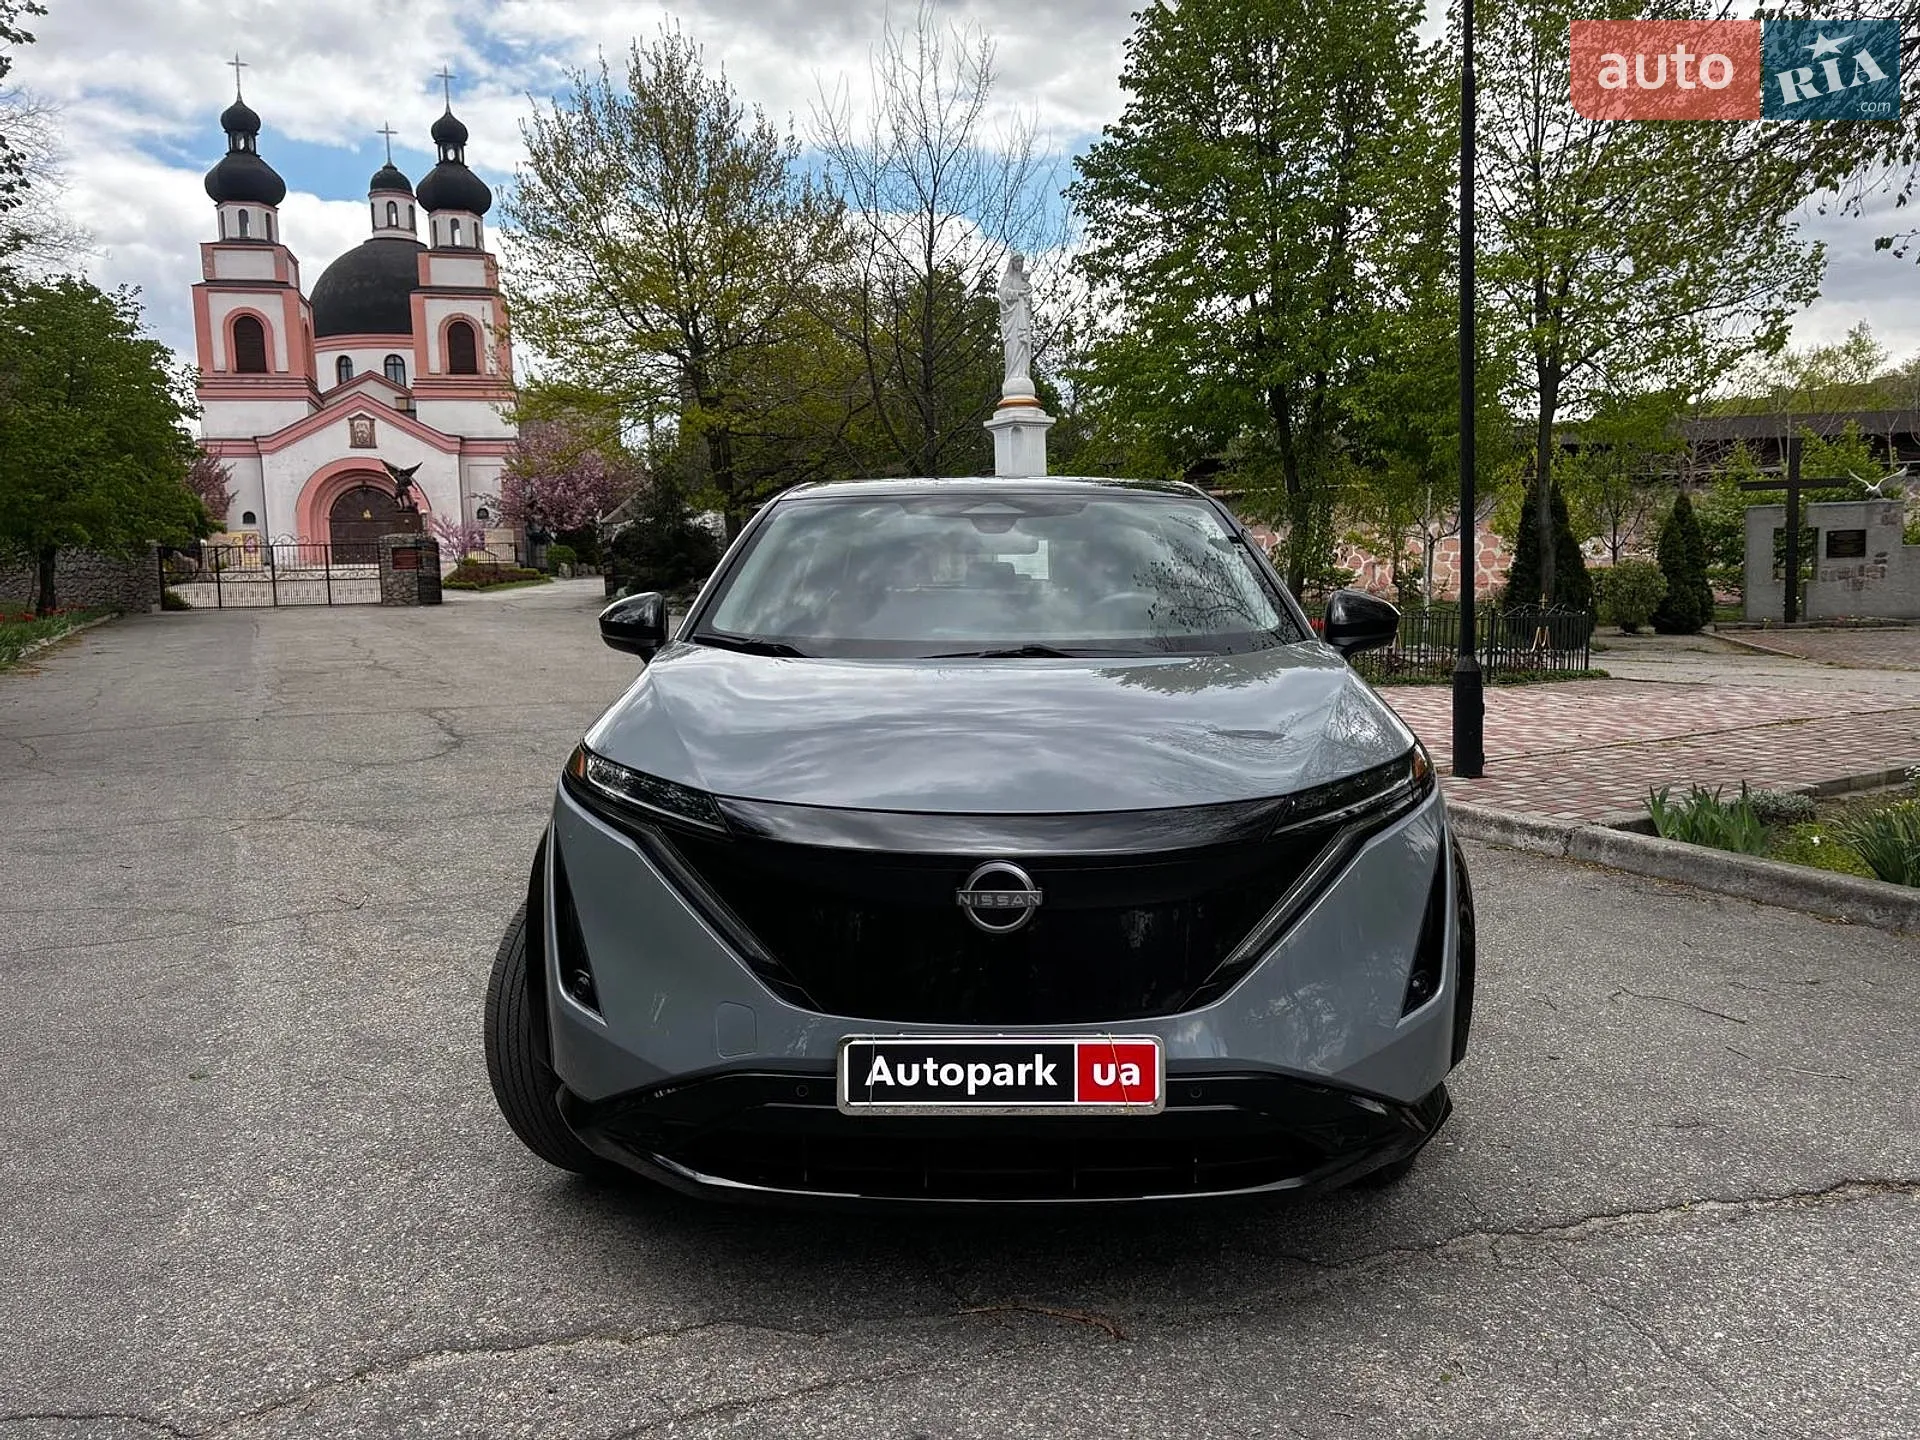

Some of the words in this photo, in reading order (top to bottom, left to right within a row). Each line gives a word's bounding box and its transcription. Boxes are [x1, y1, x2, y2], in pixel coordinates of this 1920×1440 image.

[958, 893, 1041, 906] NISSAN
[864, 1054, 1058, 1095] Autopark
[1093, 1063, 1141, 1086] ua
